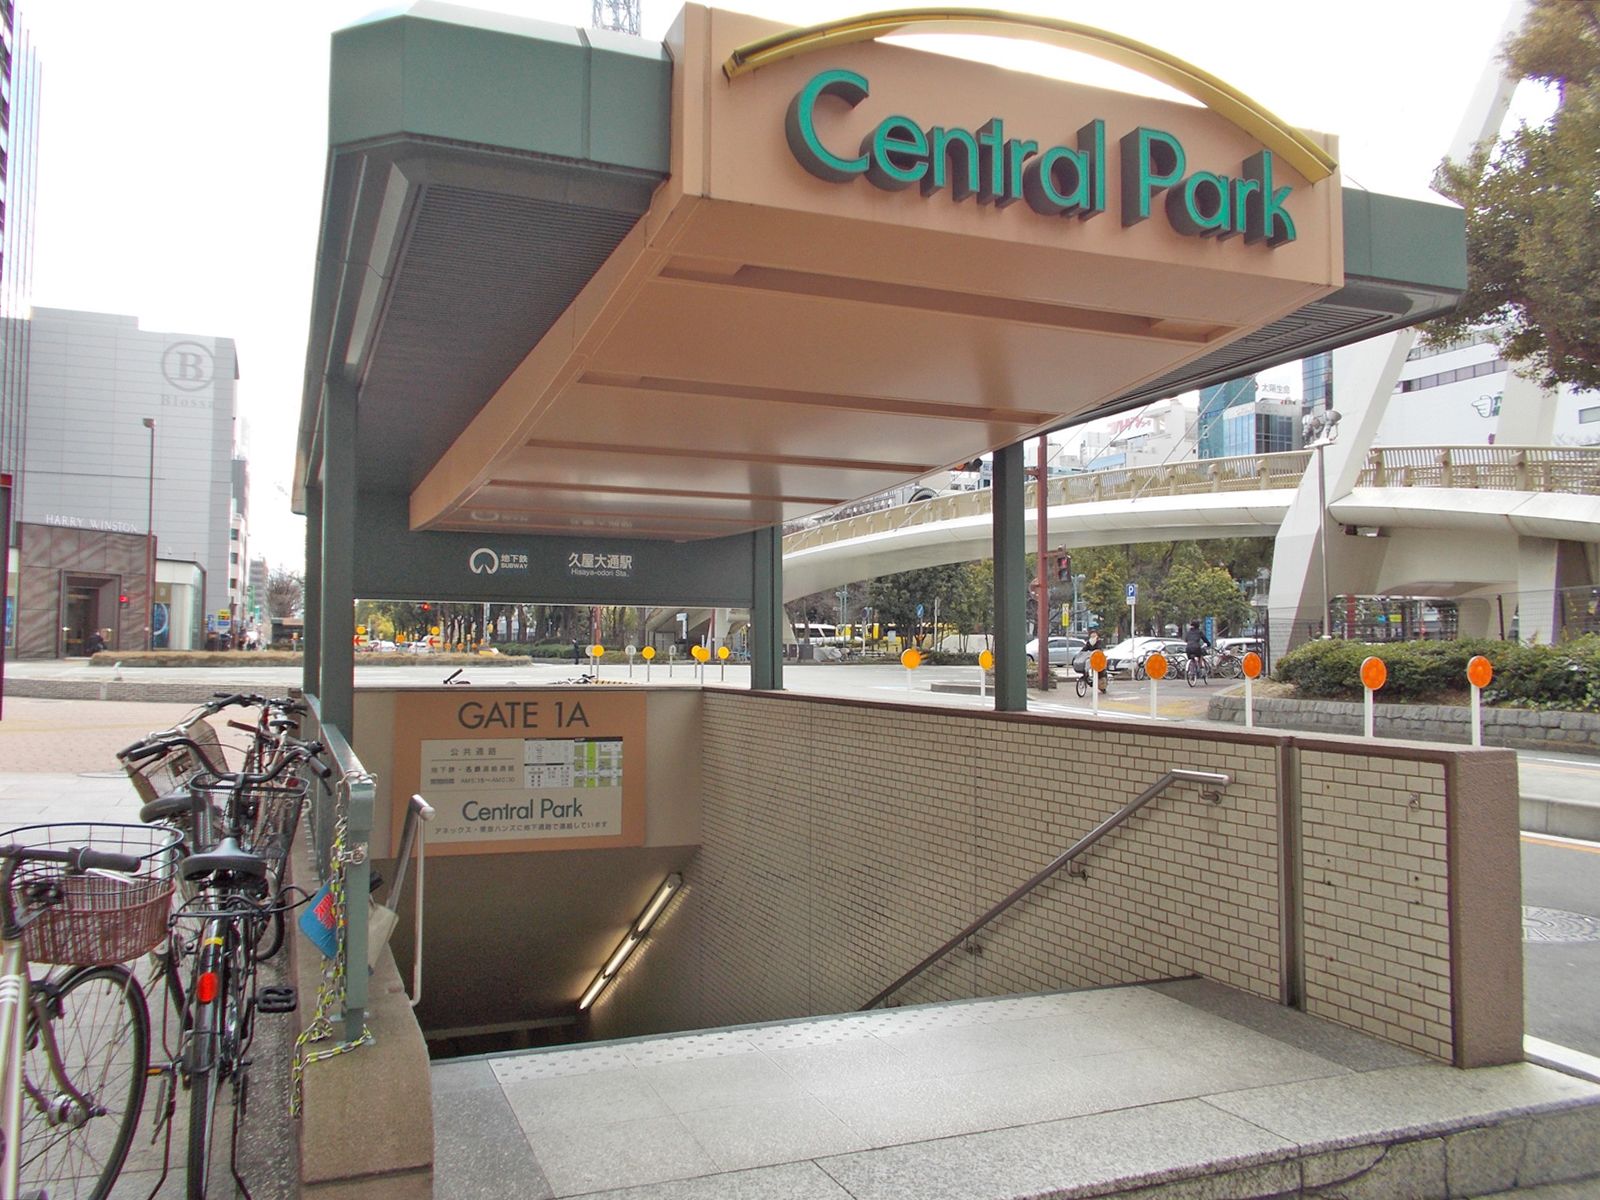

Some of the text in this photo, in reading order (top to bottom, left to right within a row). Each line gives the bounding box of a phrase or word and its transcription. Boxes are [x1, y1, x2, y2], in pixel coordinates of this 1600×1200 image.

[785, 69, 1297, 249] Central Park
[46, 514, 138, 533] HARRY WINSTON
[501, 554, 528, 563] 地下鉄
[568, 552, 633, 570] 久屋大通駅
[571, 568, 614, 577] Hisaya-odori
[457, 701, 590, 730] GATE 1A
[462, 797, 583, 822] Central Park
